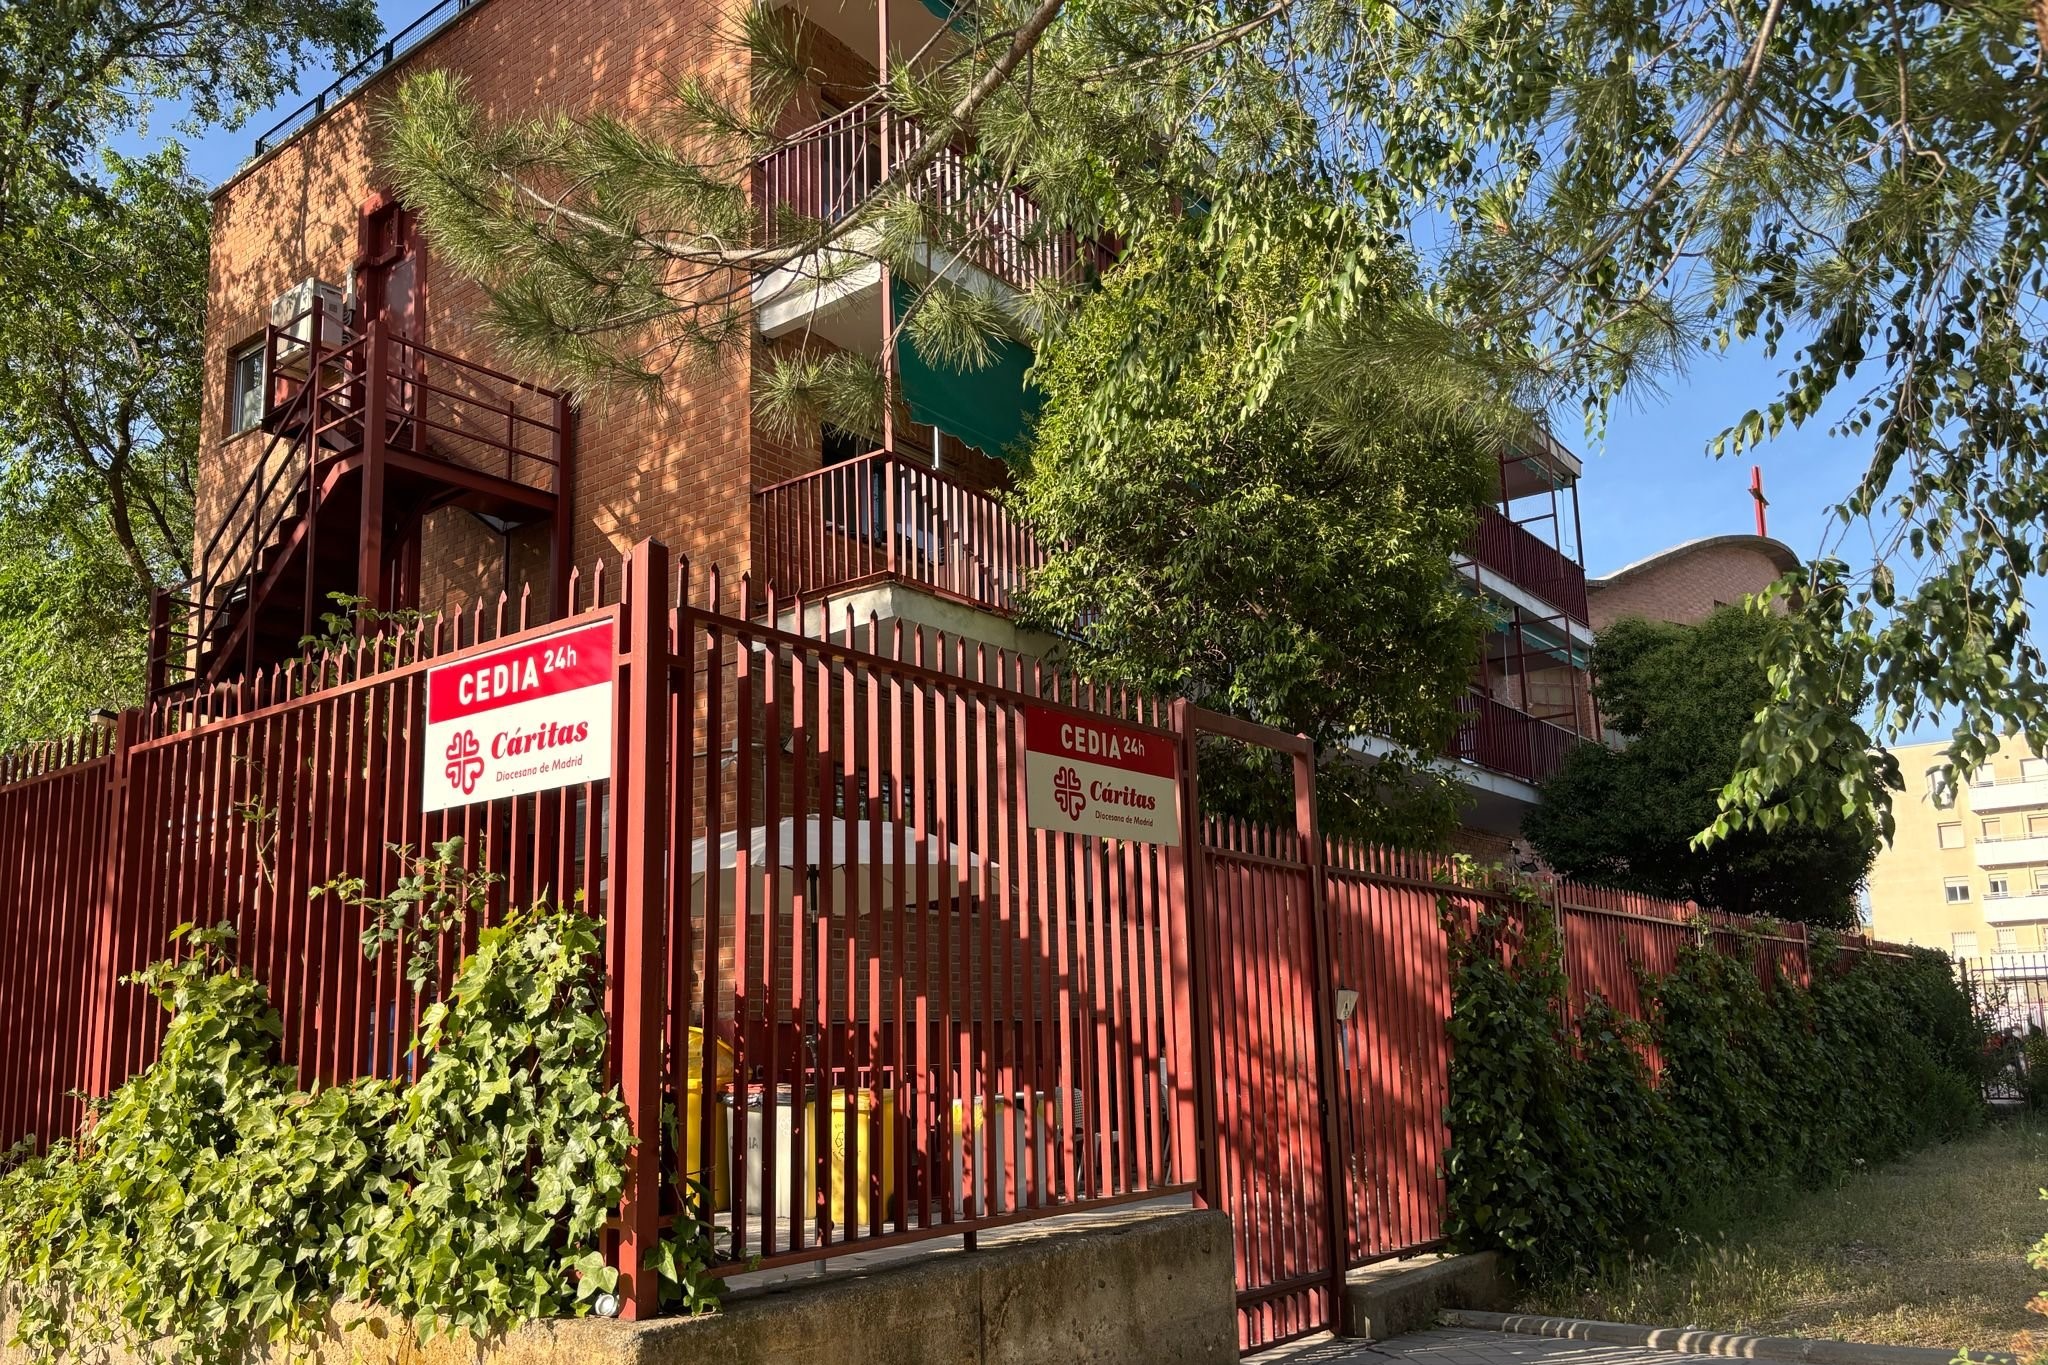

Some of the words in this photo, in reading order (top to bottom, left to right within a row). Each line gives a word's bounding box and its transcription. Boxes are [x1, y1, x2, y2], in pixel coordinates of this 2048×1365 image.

[458, 656, 540, 705] CEDIA
[543, 645, 577, 674] 24h
[491, 720, 589, 760] Cáritas
[1060, 723, 1122, 760] CEDIA
[1123, 736, 1145, 757] 24h
[496, 766, 537, 782] Diocesana
[539, 762, 550, 774] de
[552, 754, 583, 771] Madrid
[1090, 780, 1156, 811] Cáritas
[1095, 810, 1125, 823] Diocesana
[1125, 815, 1133, 824] de
[1133, 816, 1154, 827] Madrid
